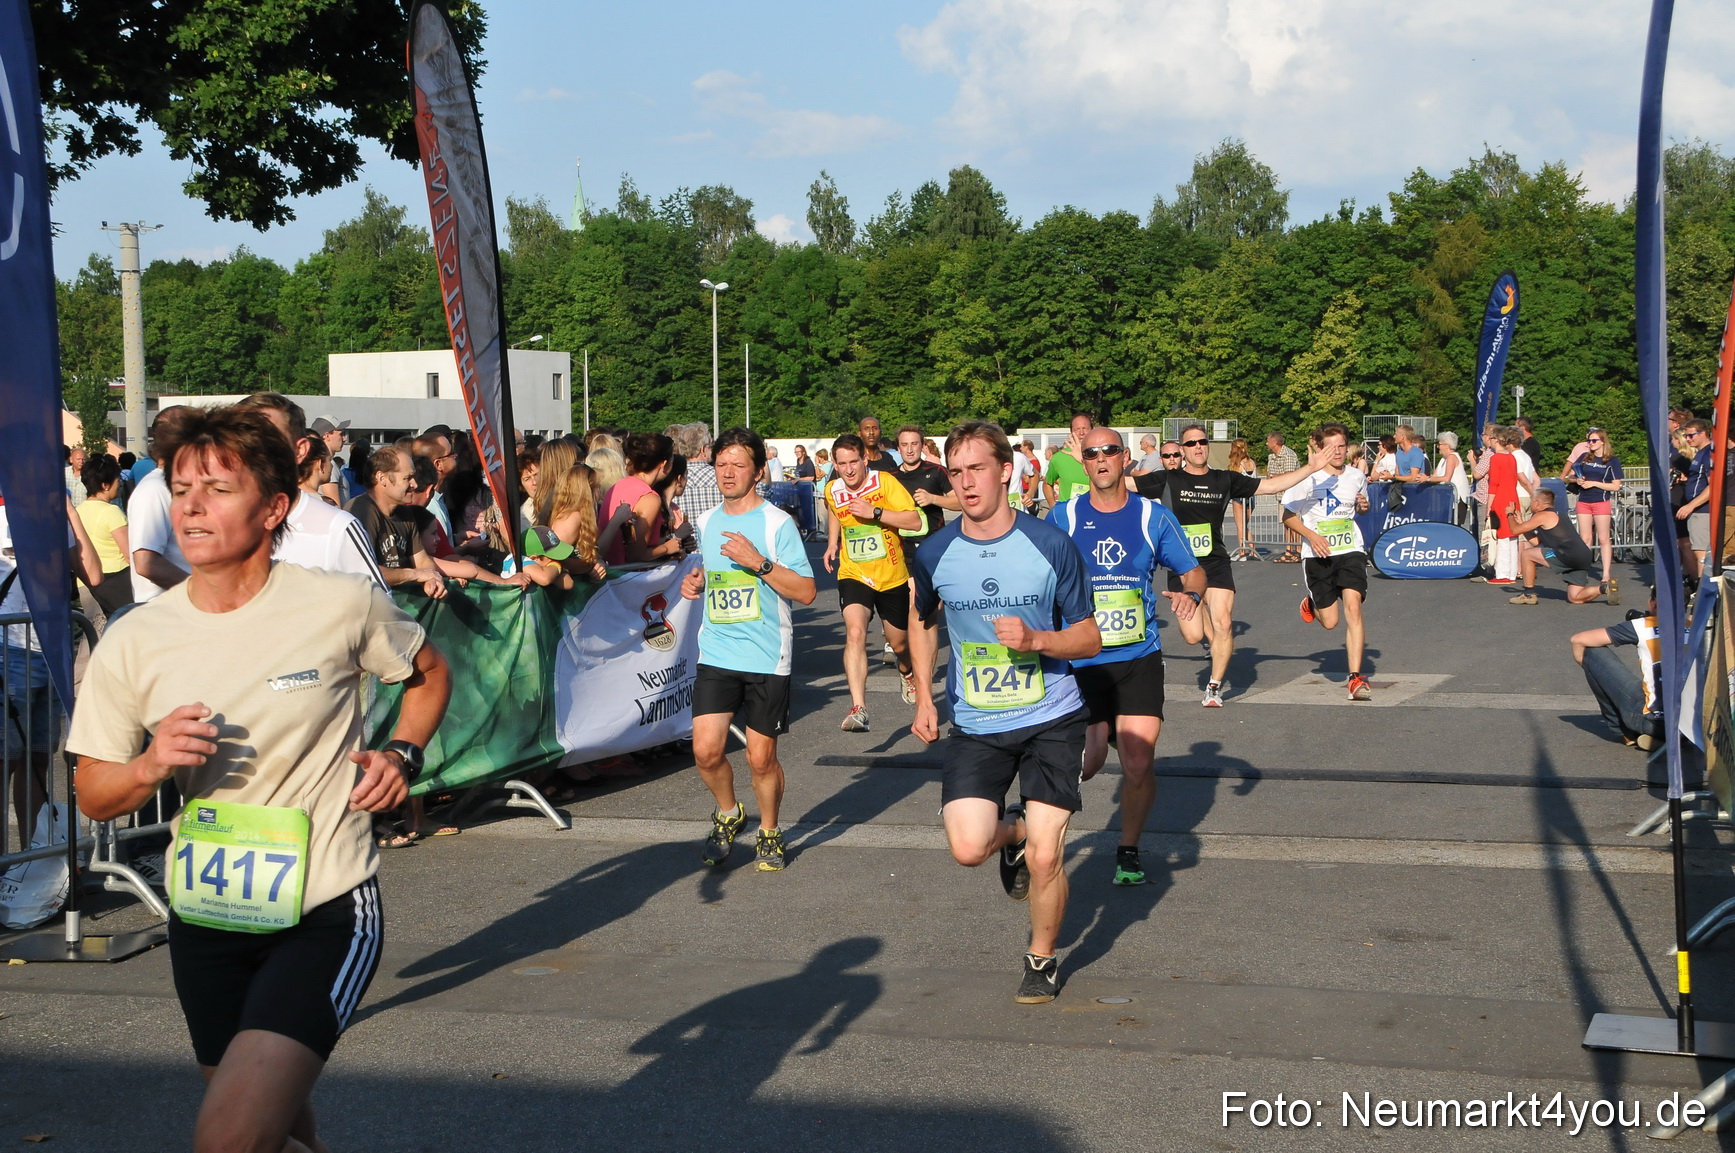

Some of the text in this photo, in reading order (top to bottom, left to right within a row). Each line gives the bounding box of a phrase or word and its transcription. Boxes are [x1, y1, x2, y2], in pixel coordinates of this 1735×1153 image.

[849, 537, 878, 554] 773
[1322, 532, 1352, 547] 076
[1400, 547, 1467, 560] Fischer
[709, 588, 755, 610] 1387
[949, 594, 1039, 612] SCHABMÜLLER
[654, 635, 672, 648] 1628
[966, 663, 1037, 693] 1247
[178, 843, 298, 903] 1417
[201, 897, 262, 912] Marianne Hummel
[180, 904, 197, 914] Vetter
[260, 916, 272, 924] Co.
[274, 917, 285, 925] KG
